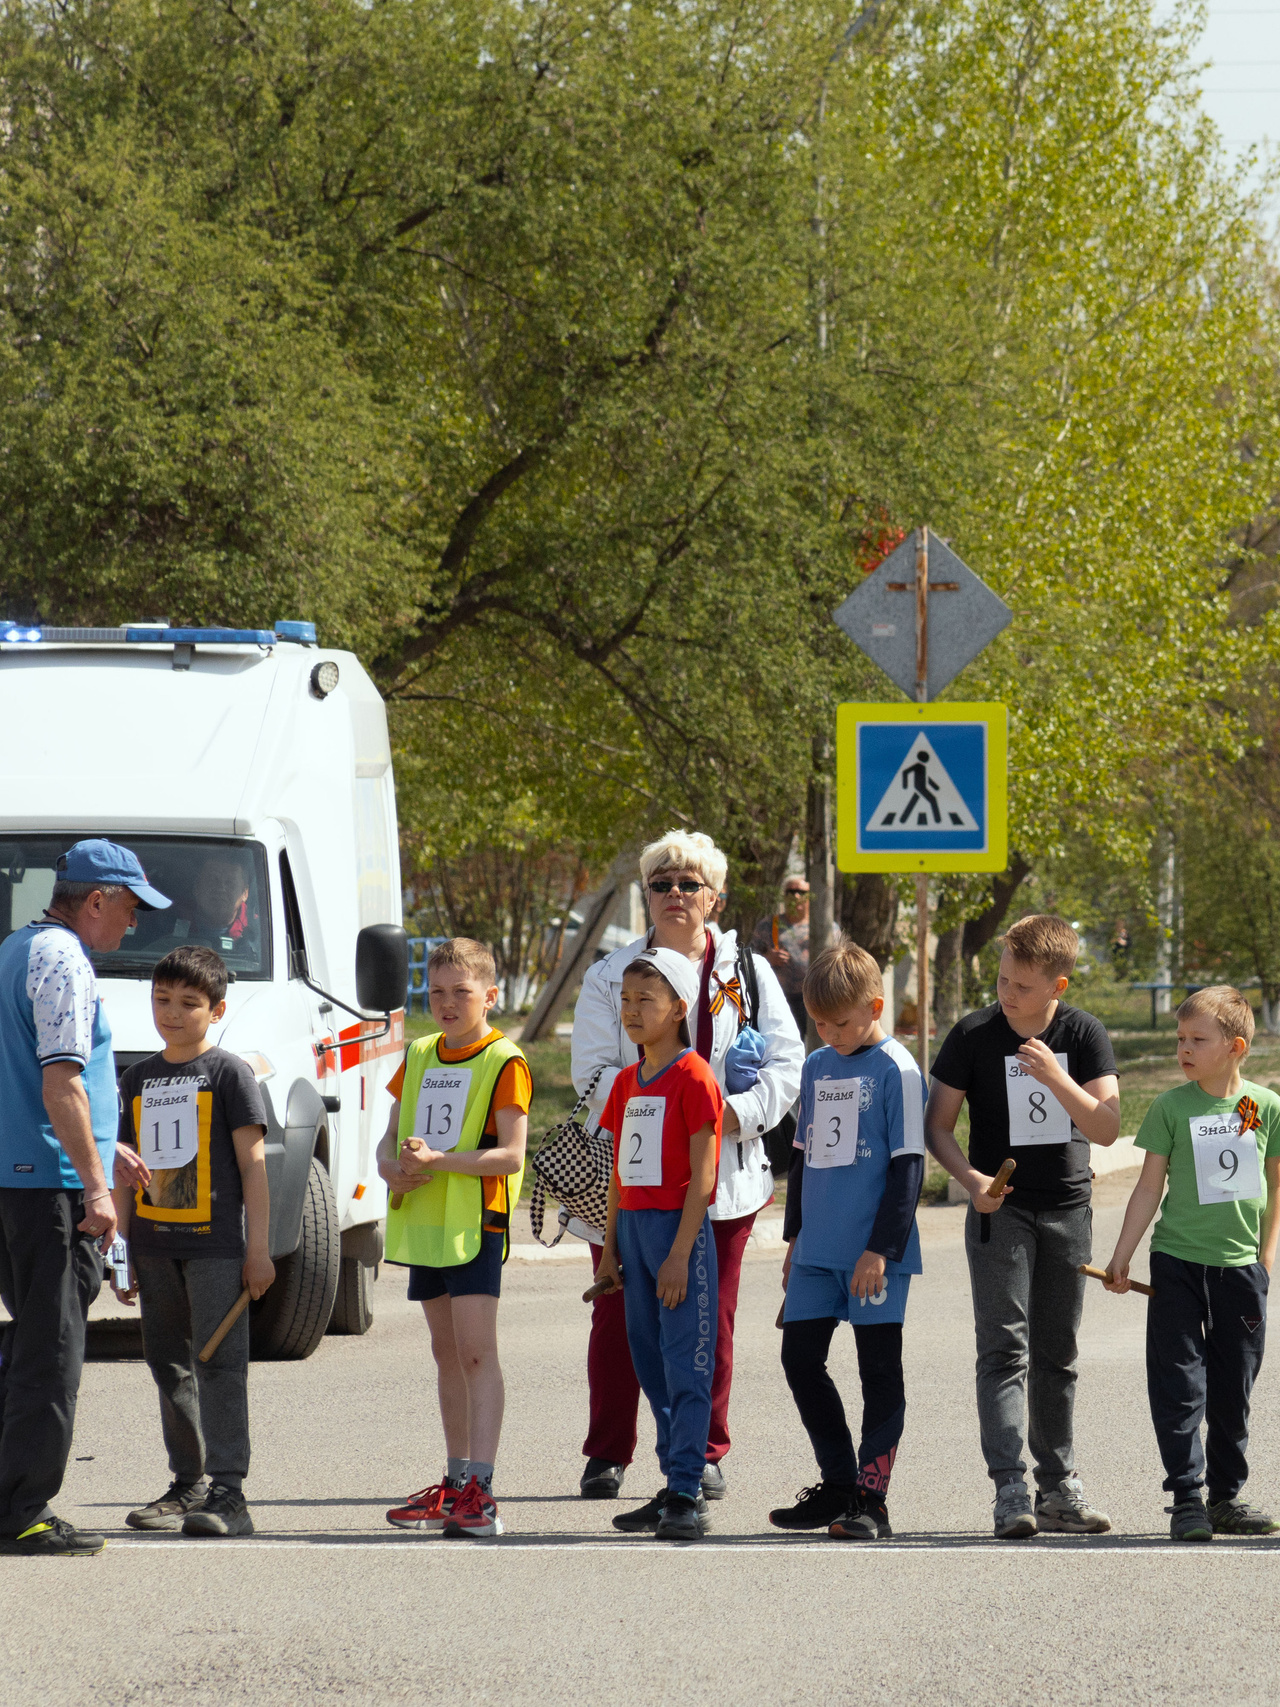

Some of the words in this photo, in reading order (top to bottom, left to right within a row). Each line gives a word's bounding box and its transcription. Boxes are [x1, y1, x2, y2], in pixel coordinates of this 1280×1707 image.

[142, 1077, 168, 1090] THE
[422, 1078, 462, 1089] Знамя
[143, 1094, 189, 1109] Знамя
[817, 1090, 854, 1102] Знамя
[1028, 1091, 1047, 1124] 8
[423, 1103, 452, 1135] 13
[625, 1107, 656, 1118] Знамя
[152, 1119, 184, 1152] 11
[826, 1116, 841, 1148] 3
[1198, 1125, 1240, 1136] Знам
[628, 1132, 643, 1165] 2
[1218, 1149, 1239, 1182] 9
